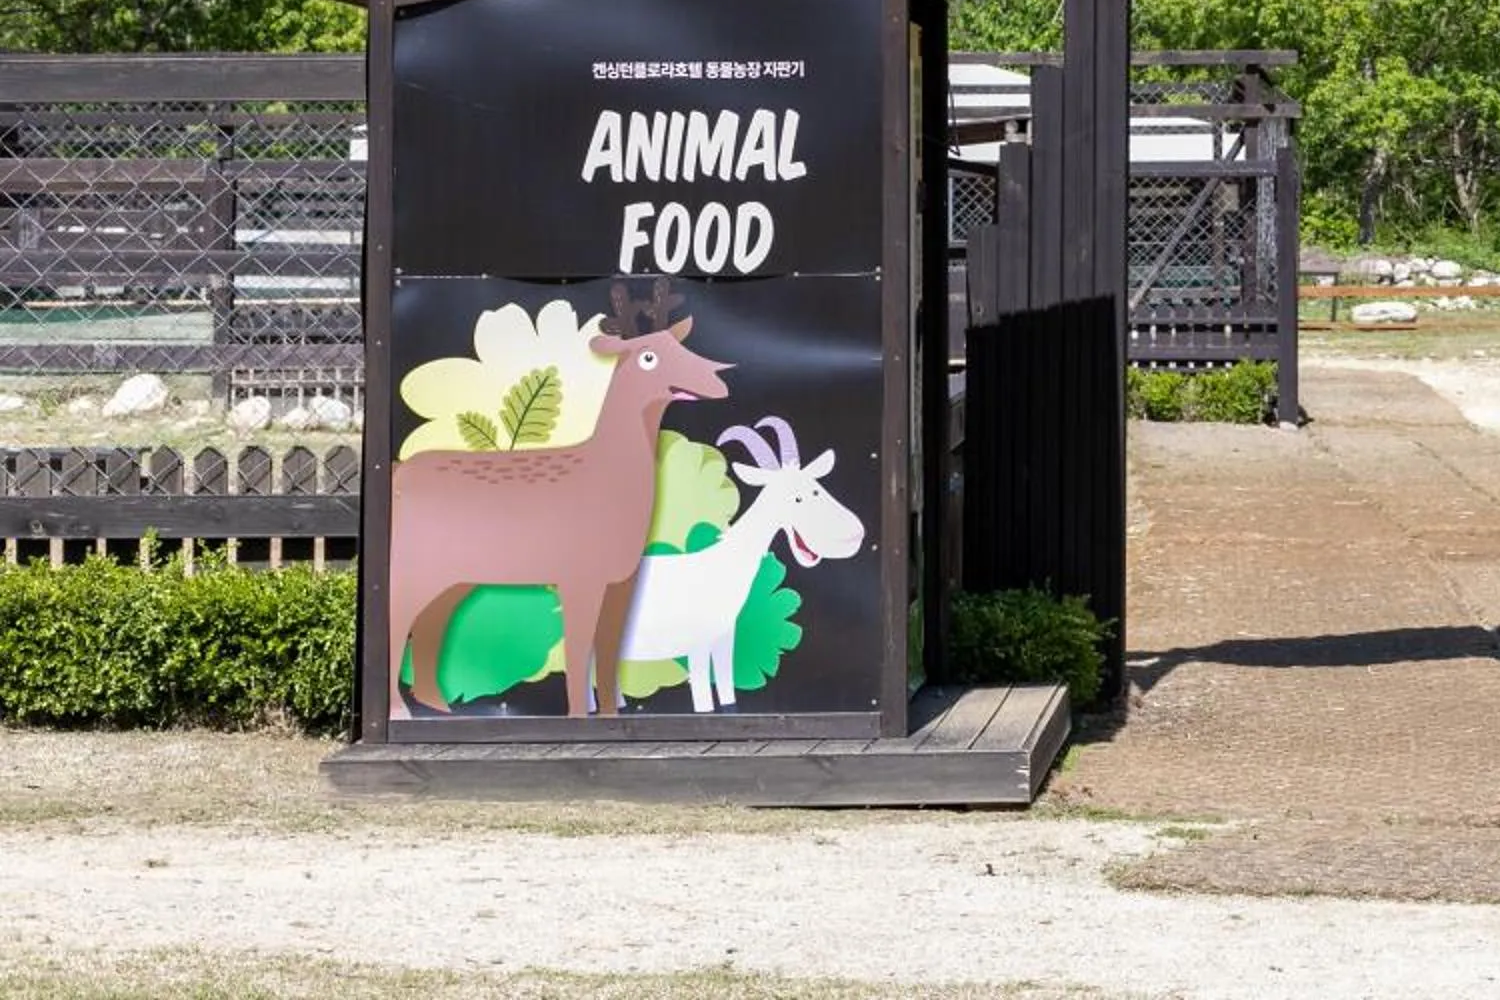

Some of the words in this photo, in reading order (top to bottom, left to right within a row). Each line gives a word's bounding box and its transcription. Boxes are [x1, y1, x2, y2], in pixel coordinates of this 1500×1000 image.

[705, 61, 760, 79] 동물농장
[763, 60, 805, 78] 자판기
[581, 109, 807, 183] ANIMAL
[619, 201, 775, 275] FOOD
